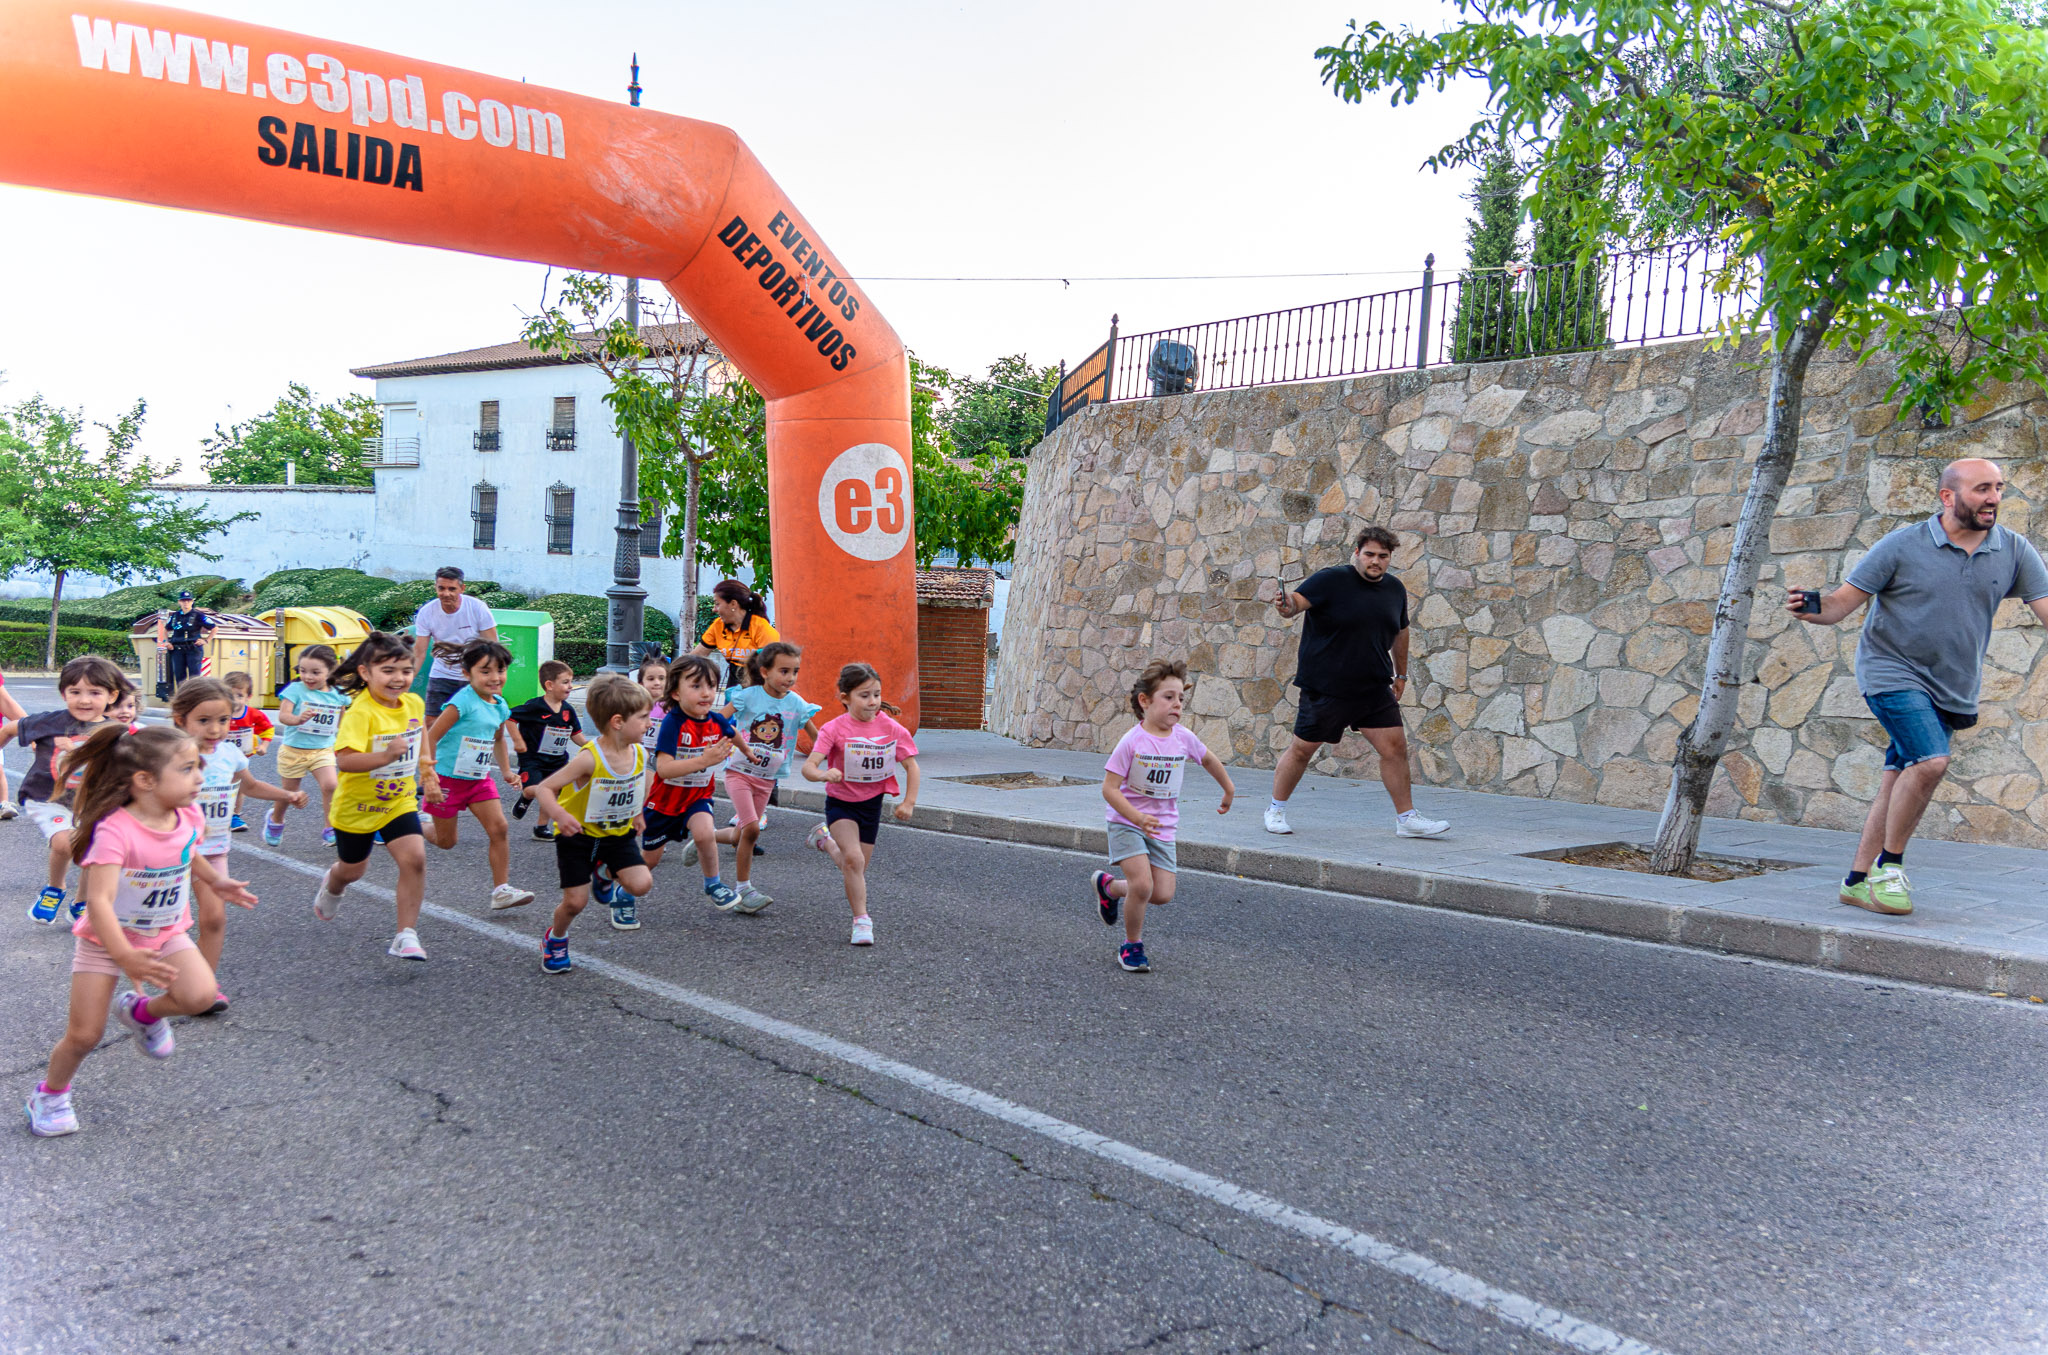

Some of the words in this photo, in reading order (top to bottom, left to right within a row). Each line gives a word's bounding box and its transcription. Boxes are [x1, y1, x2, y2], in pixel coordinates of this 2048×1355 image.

[71, 14, 566, 159] www.e3pd.com
[257, 115, 423, 192] SALIDA
[767, 210, 860, 322] EVENTOS
[717, 215, 857, 372] DEPORTIVOS
[834, 467, 905, 535] e3
[313, 713, 335, 726] 403
[645, 727, 655, 738] 12
[681, 732, 692, 746] 10
[554, 737, 568, 747] 401
[399, 745, 414, 762] 11
[746, 753, 771, 768] 08
[861, 756, 884, 770] 419
[1147, 769, 1172, 784] 407
[607, 790, 634, 807] 405
[142, 885, 182, 909] 415
